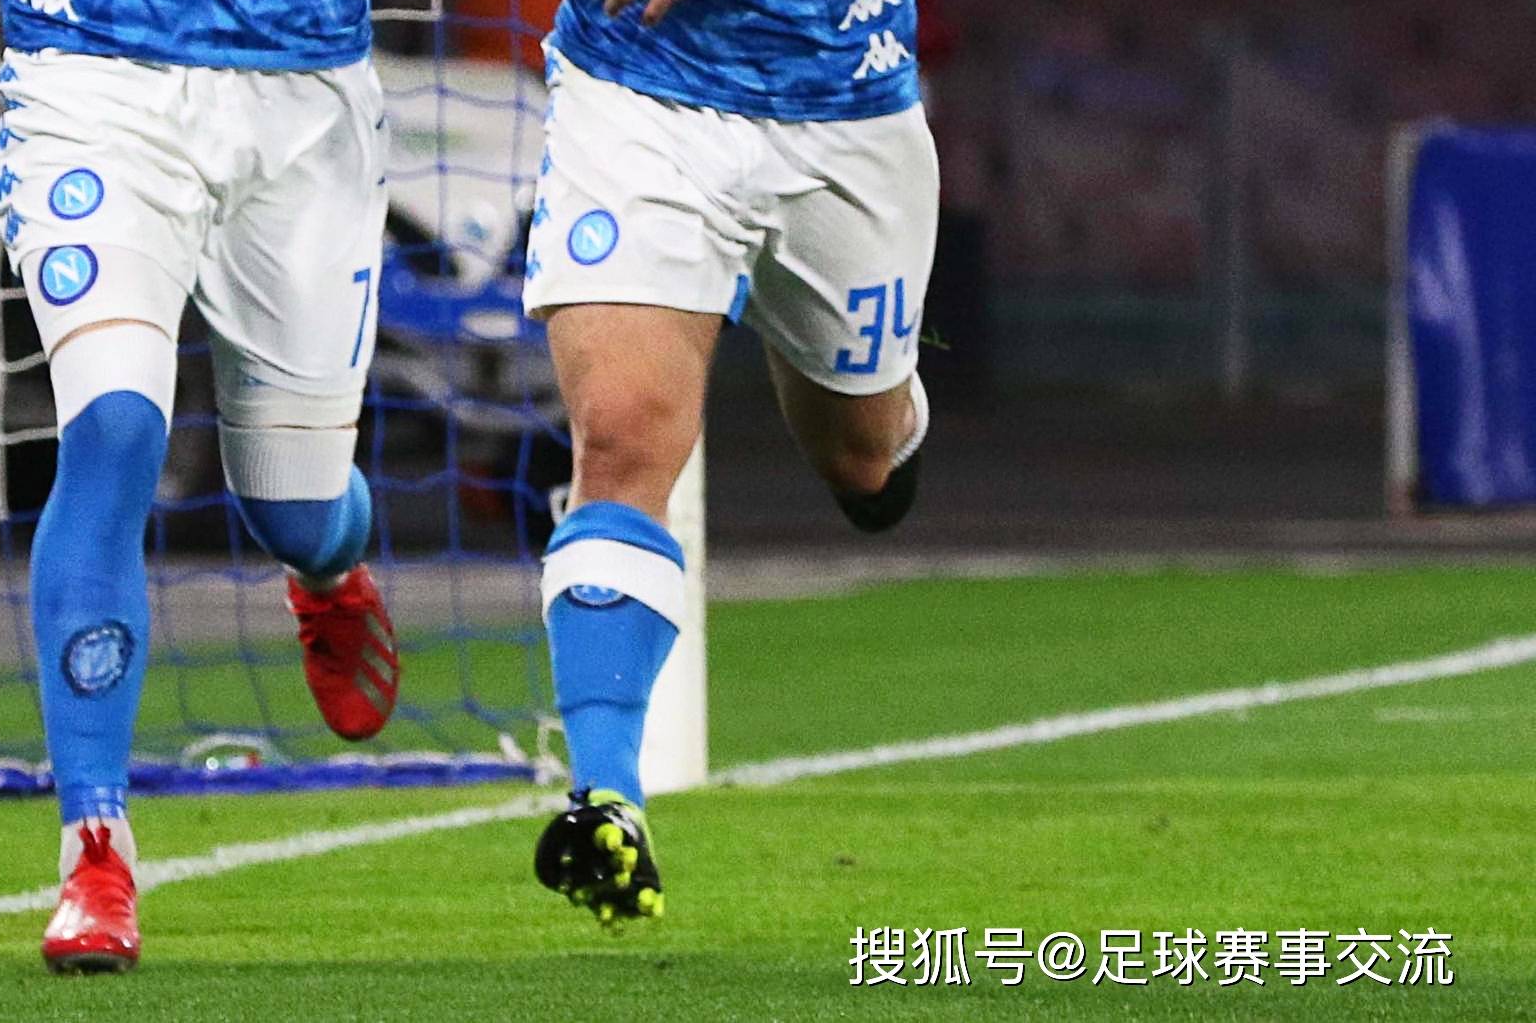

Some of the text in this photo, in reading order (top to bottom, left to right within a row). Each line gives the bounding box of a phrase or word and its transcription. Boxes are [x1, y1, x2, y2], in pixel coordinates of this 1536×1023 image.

[63, 179, 89, 209] N
[580, 225, 607, 252] N
[47, 253, 80, 290] N
[350, 267, 371, 368] 7
